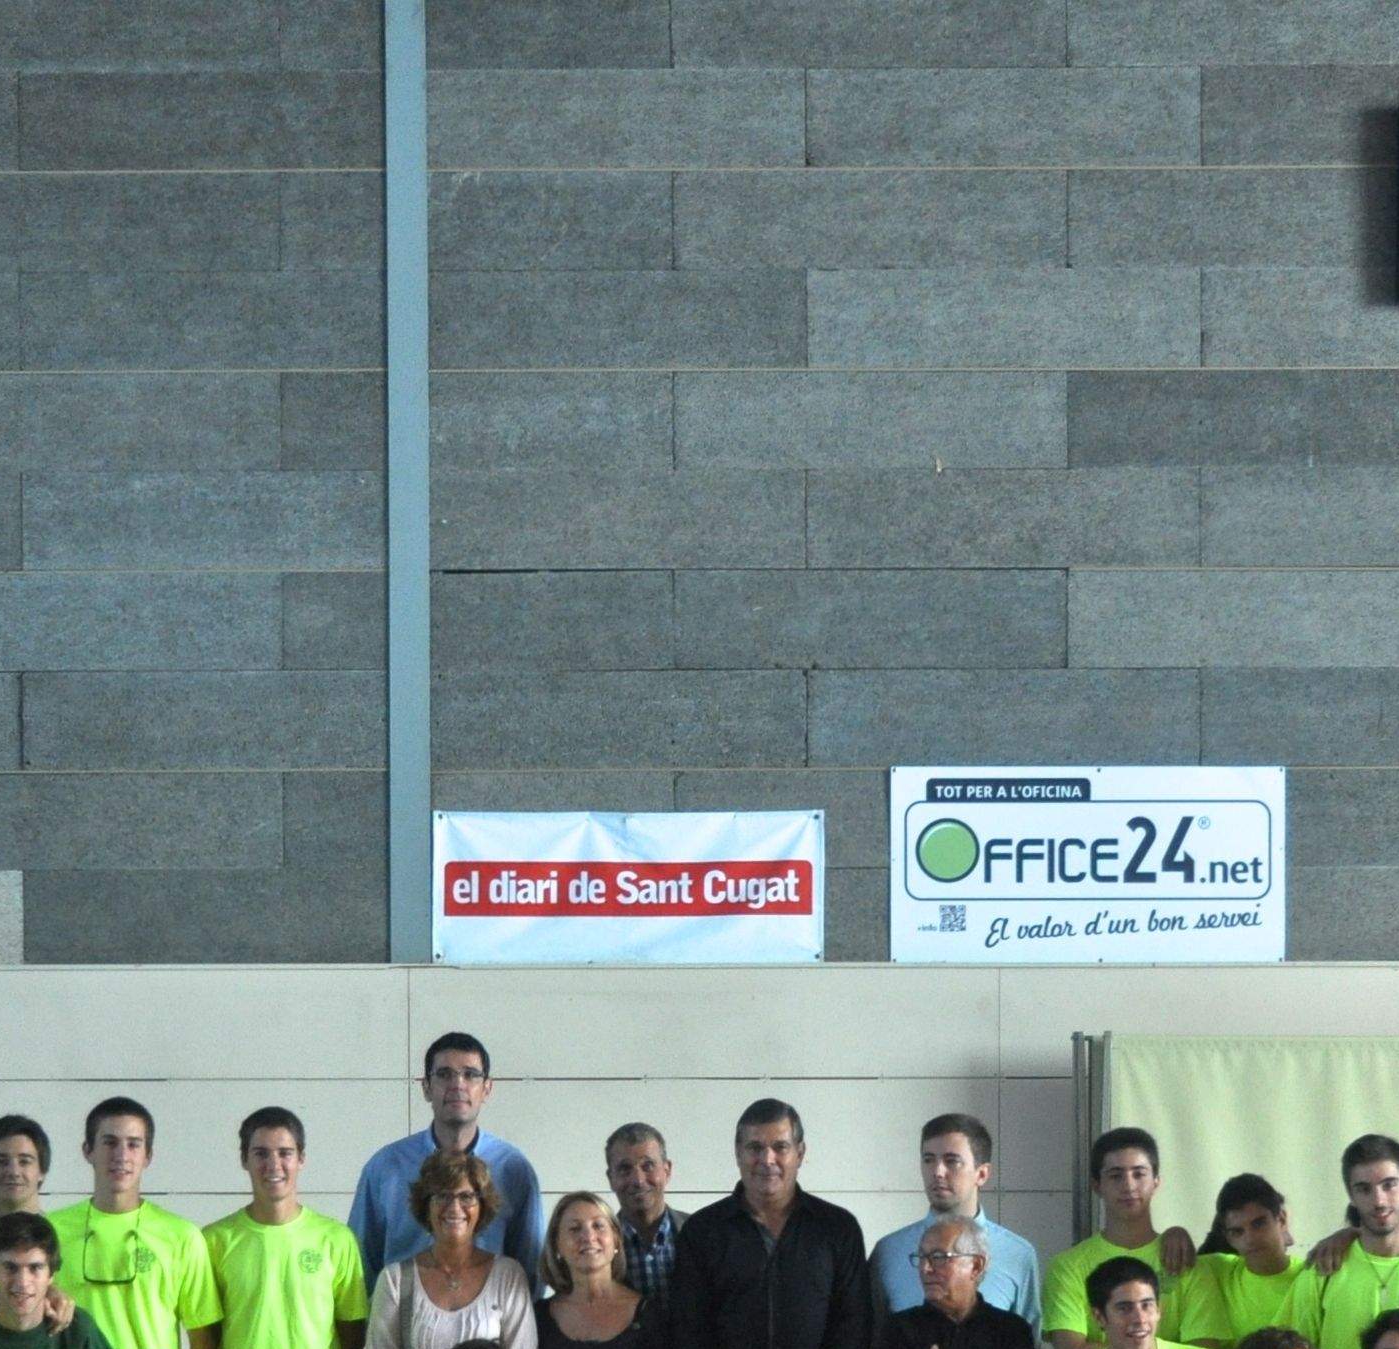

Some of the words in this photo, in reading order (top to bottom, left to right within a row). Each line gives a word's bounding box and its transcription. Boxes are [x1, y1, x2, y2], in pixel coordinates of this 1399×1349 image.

[934, 785, 964, 799] TOT
[966, 785, 993, 798] PER
[995, 785, 1008, 798] A
[1011, 785, 1083, 798] L'OFICINA
[452, 870, 480, 904] el
[488, 870, 558, 904] diari
[568, 870, 606, 904] de
[616, 870, 694, 905] Sant
[703, 868, 800, 910] Cugat
[984, 916, 1010, 948] El
[1017, 915, 1077, 940] valor
[1084, 910, 1140, 936] d'un
[1147, 909, 1188, 932] bon
[1193, 903, 1263, 929] servei
